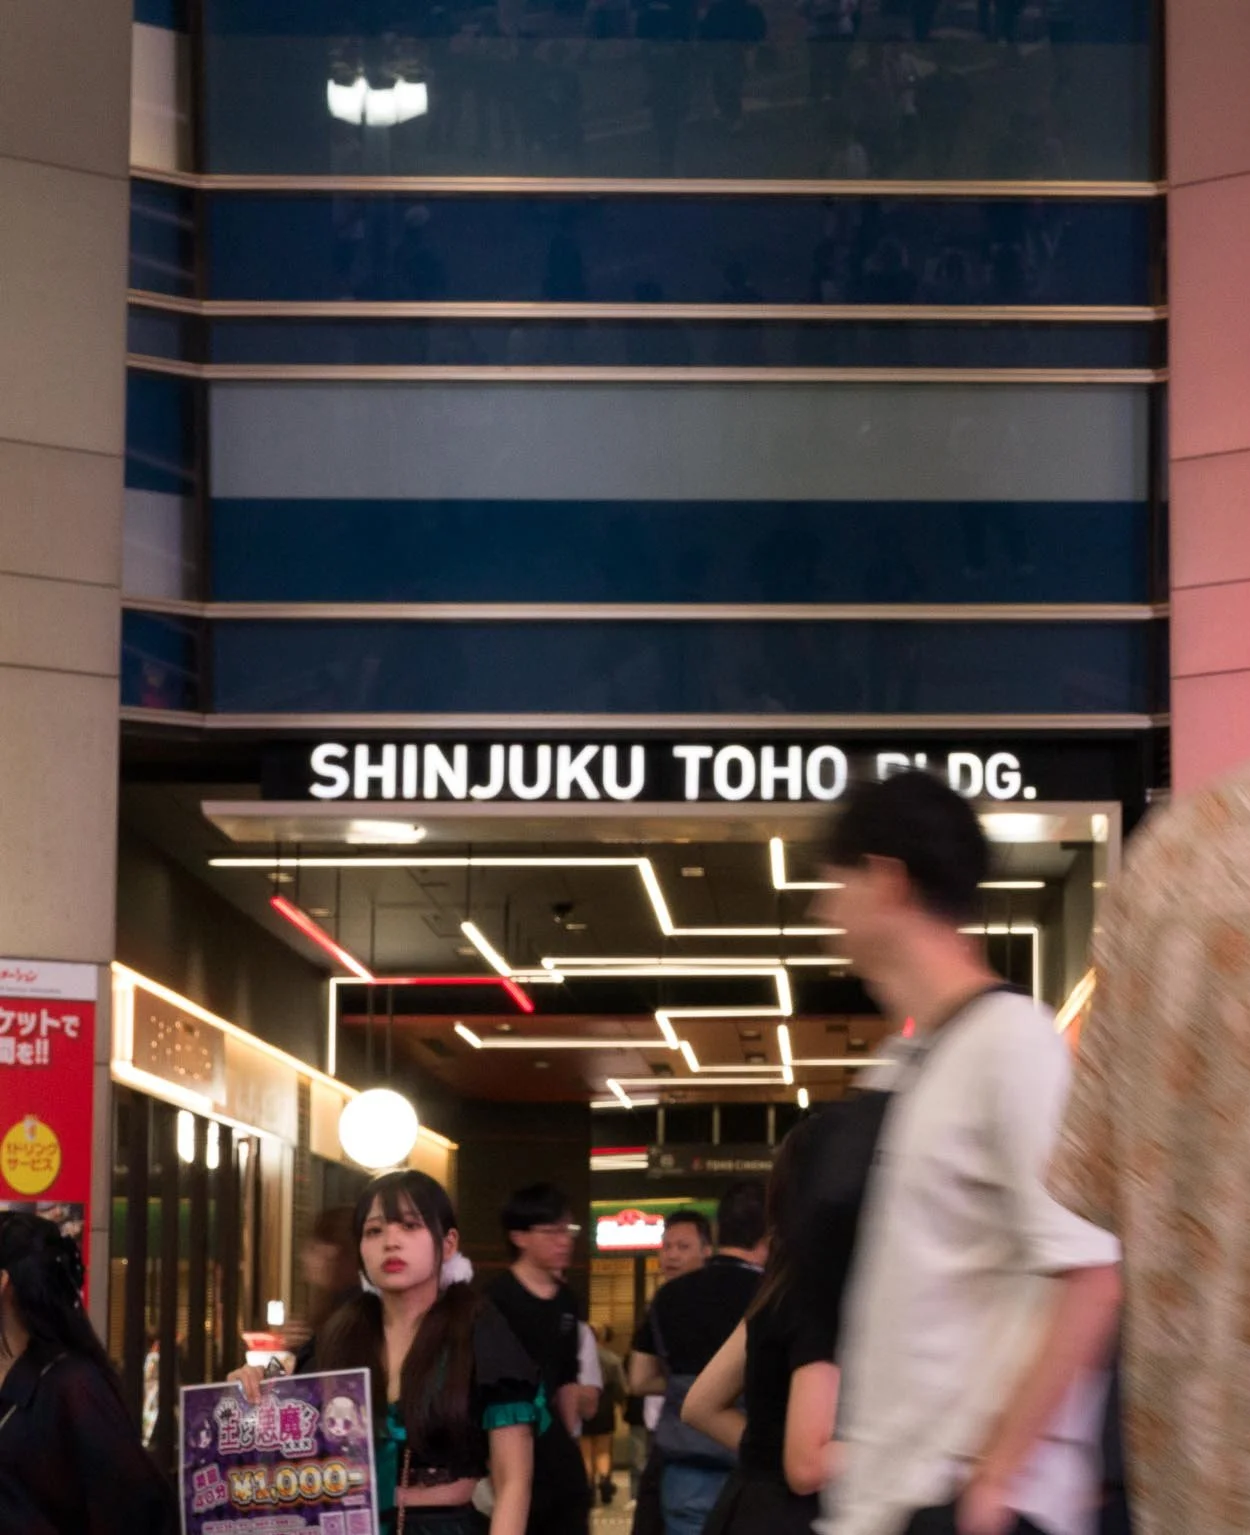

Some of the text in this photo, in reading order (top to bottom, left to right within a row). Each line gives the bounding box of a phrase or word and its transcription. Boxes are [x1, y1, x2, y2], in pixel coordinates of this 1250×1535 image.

[309, 743, 1036, 801] SHINJUKU TOHO DG.
